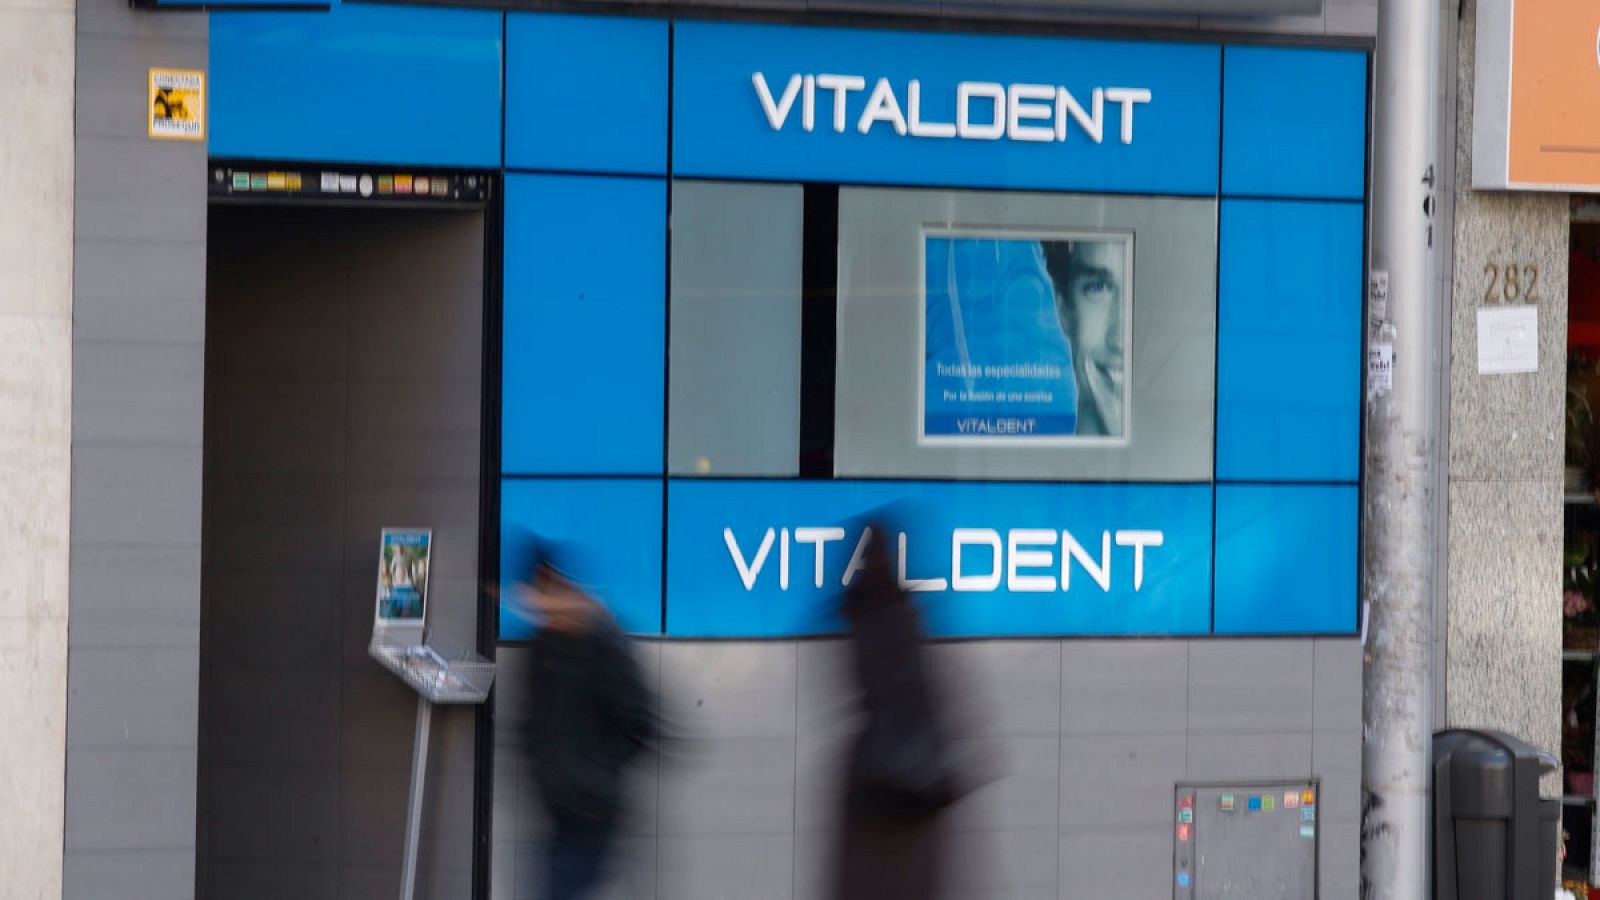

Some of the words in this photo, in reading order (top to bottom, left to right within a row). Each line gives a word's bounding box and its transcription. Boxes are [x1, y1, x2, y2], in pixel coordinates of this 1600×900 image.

[751, 71, 1152, 145] VITALDENT
[1483, 262, 1540, 304] 282
[984, 363, 1060, 379] especialidades
[957, 418, 1036, 434] VITALDENT
